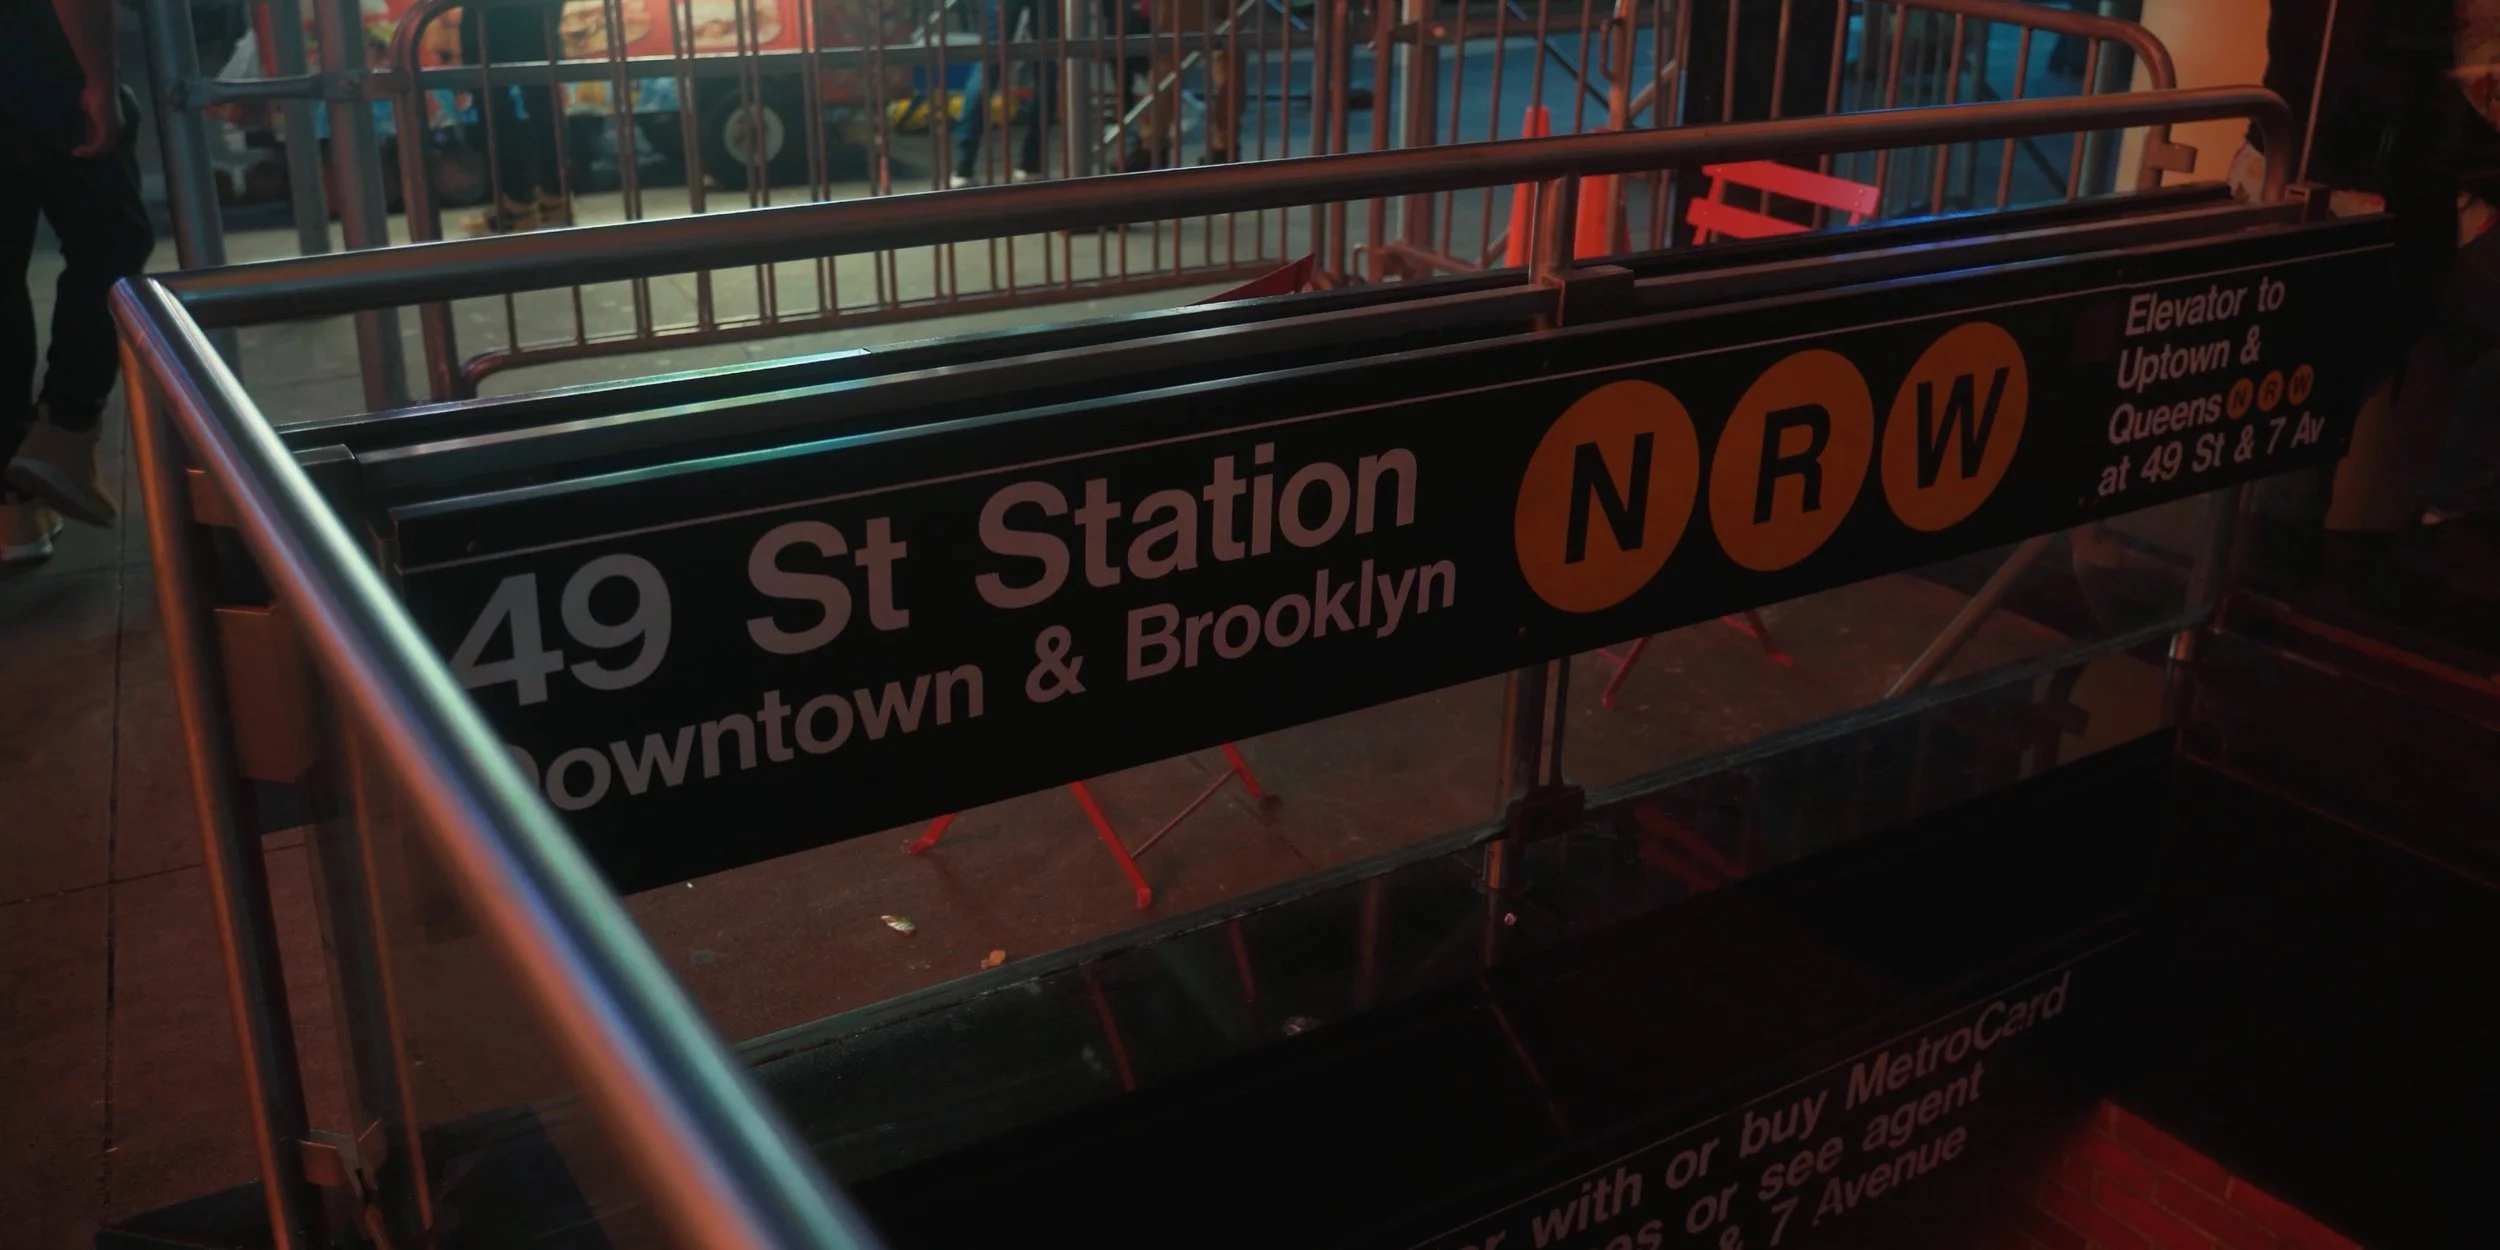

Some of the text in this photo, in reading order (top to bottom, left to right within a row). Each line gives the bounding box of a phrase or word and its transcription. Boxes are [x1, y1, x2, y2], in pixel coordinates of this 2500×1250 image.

[2116, 325, 2261, 395] Uptown &
[2124, 276, 2286, 337] Elevator to
[1564, 367, 2010, 565] N R W
[2097, 410, 2326, 497] at 49 St & 7 Av
[2108, 392, 2223, 446] Queens
[448, 442, 1418, 706] 49 St Station
[1025, 624, 1087, 704] &
[1126, 558, 1457, 682] Brooklyn
[1531, 970, 2072, 1248] with or buy MetroCard
[1685, 1181, 1739, 1235] or
[1758, 1135, 1844, 1201] see
[1861, 1060, 1985, 1153] agent
[1769, 1195, 1799, 1248] 7
[1812, 1124, 1967, 1228] Avenue
